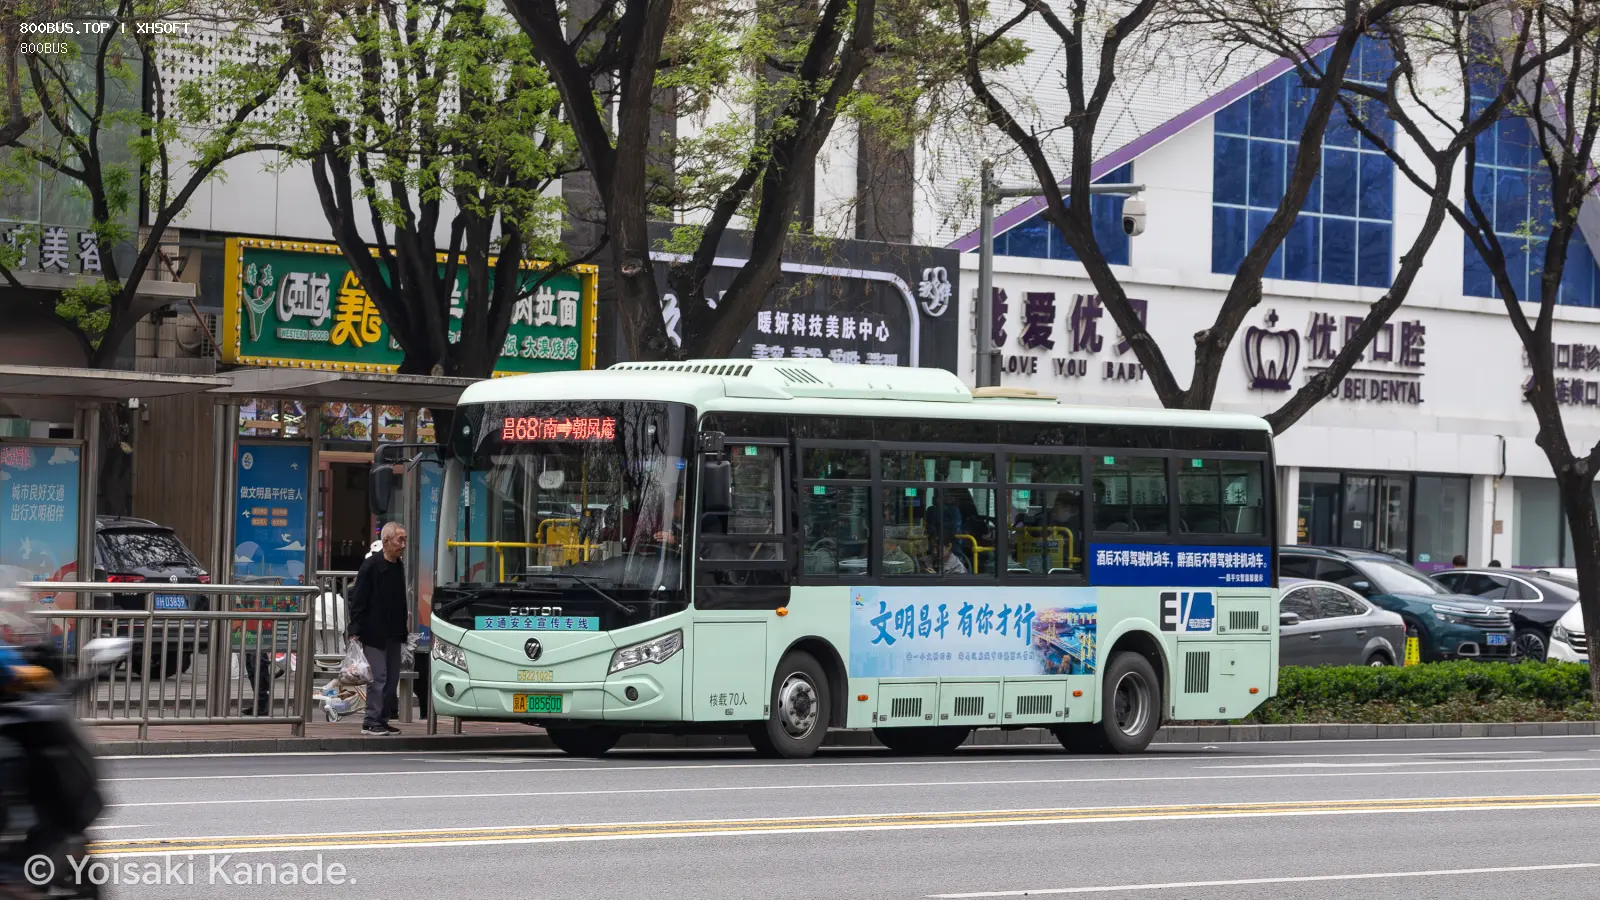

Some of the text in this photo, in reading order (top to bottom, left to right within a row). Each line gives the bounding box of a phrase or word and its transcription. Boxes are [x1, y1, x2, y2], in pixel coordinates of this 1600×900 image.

[280, 328, 329, 341] WESTERN FOODS
[757, 310, 890, 343] 暖妍科技美肤中心
[1000, 354, 1145, 381] LOVE YOU BABY
[1342, 377, 1366, 400] BEI
[1369, 379, 1425, 404] DENTAL
[502, 417, 538, 440] 昌68
[11, 483, 65, 501] 城市良好交通
[240, 486, 304, 501] 做文明昌平代言人
[11, 503, 65, 522] 出行文明相伴
[509, 606, 562, 616] FOTON
[484, 617, 588, 629] 交通安全宣传专线
[869, 600, 1036, 647] 文明昌平 有你才行
[709, 692, 748, 706] 核载70人
